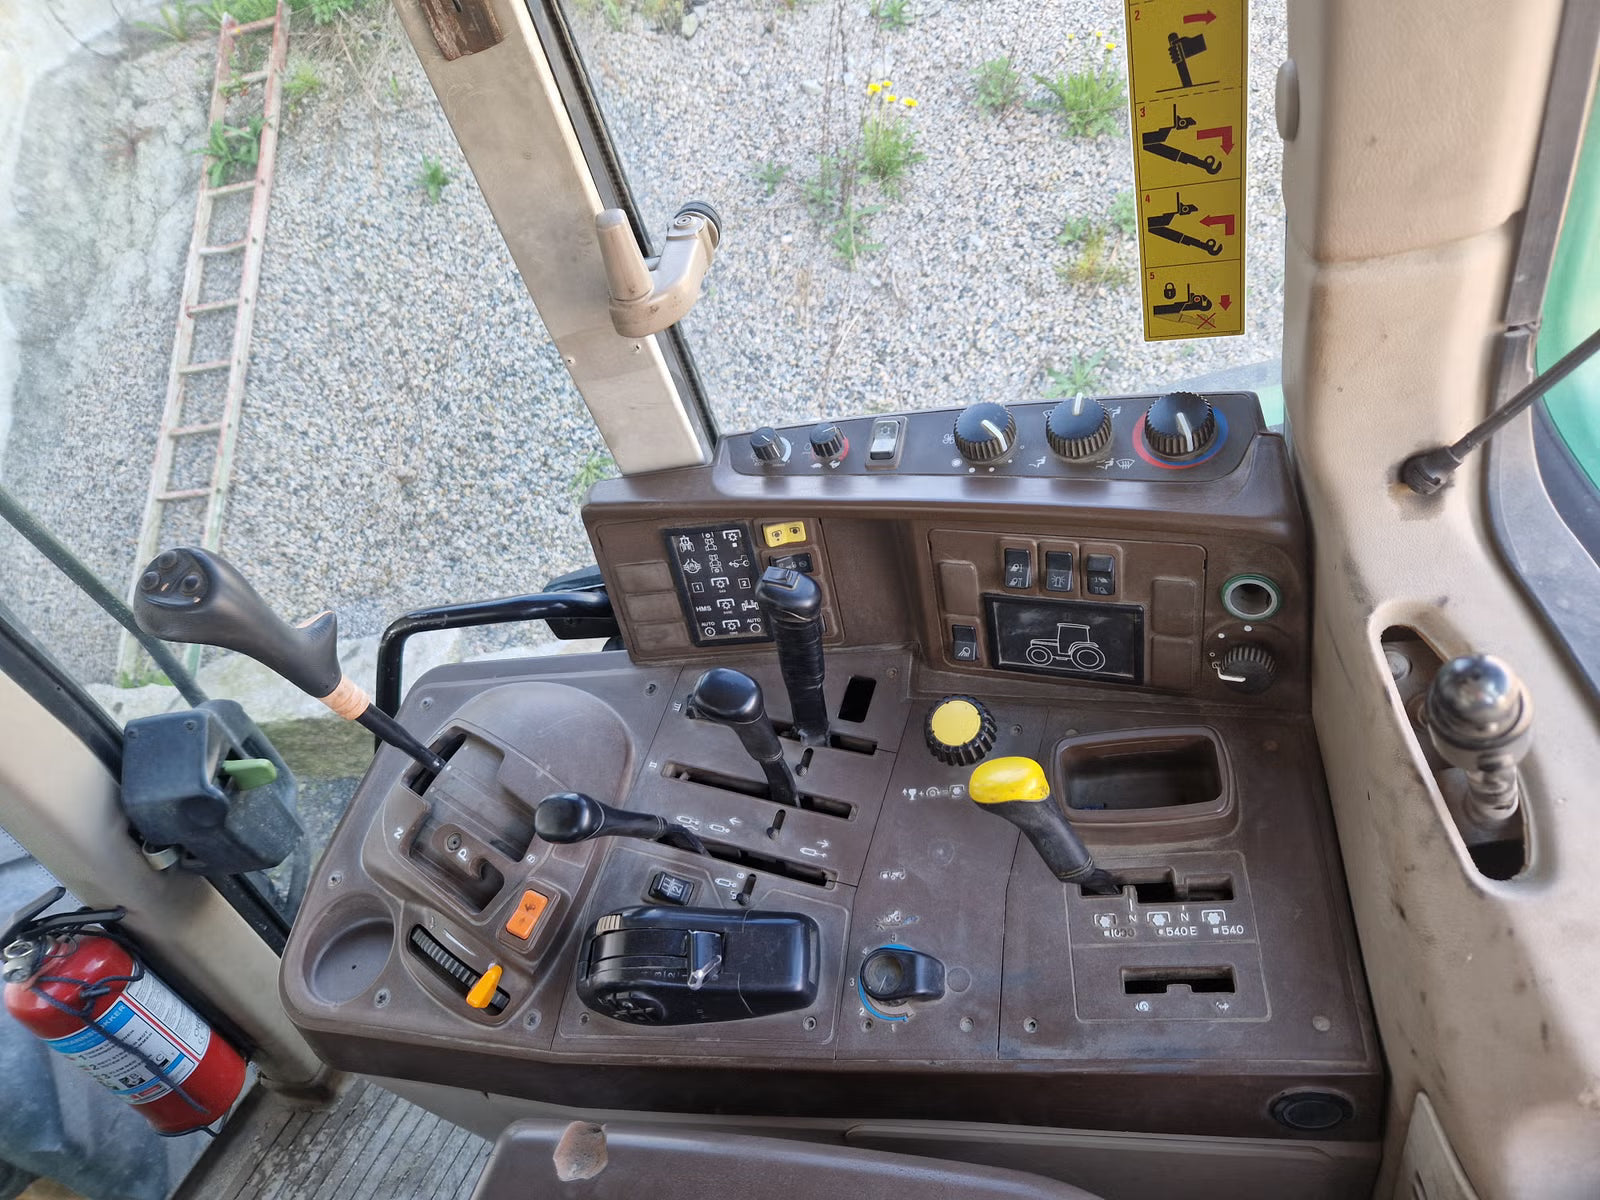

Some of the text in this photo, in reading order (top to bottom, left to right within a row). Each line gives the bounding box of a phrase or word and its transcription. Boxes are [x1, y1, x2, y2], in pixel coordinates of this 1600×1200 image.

[1134, 10, 1140, 22] 2
[1139, 106, 1146, 118] 3
[1145, 193, 1150, 203] 4
[1150, 272, 1155, 280] 5
[457, 848, 468, 862] P
[1128, 914, 1137, 923] N
[1180, 912, 1189, 921] N
[1221, 925, 1244, 935] 540
[849, 977, 855, 987] 3
[859, 1007, 865, 1016] 2
